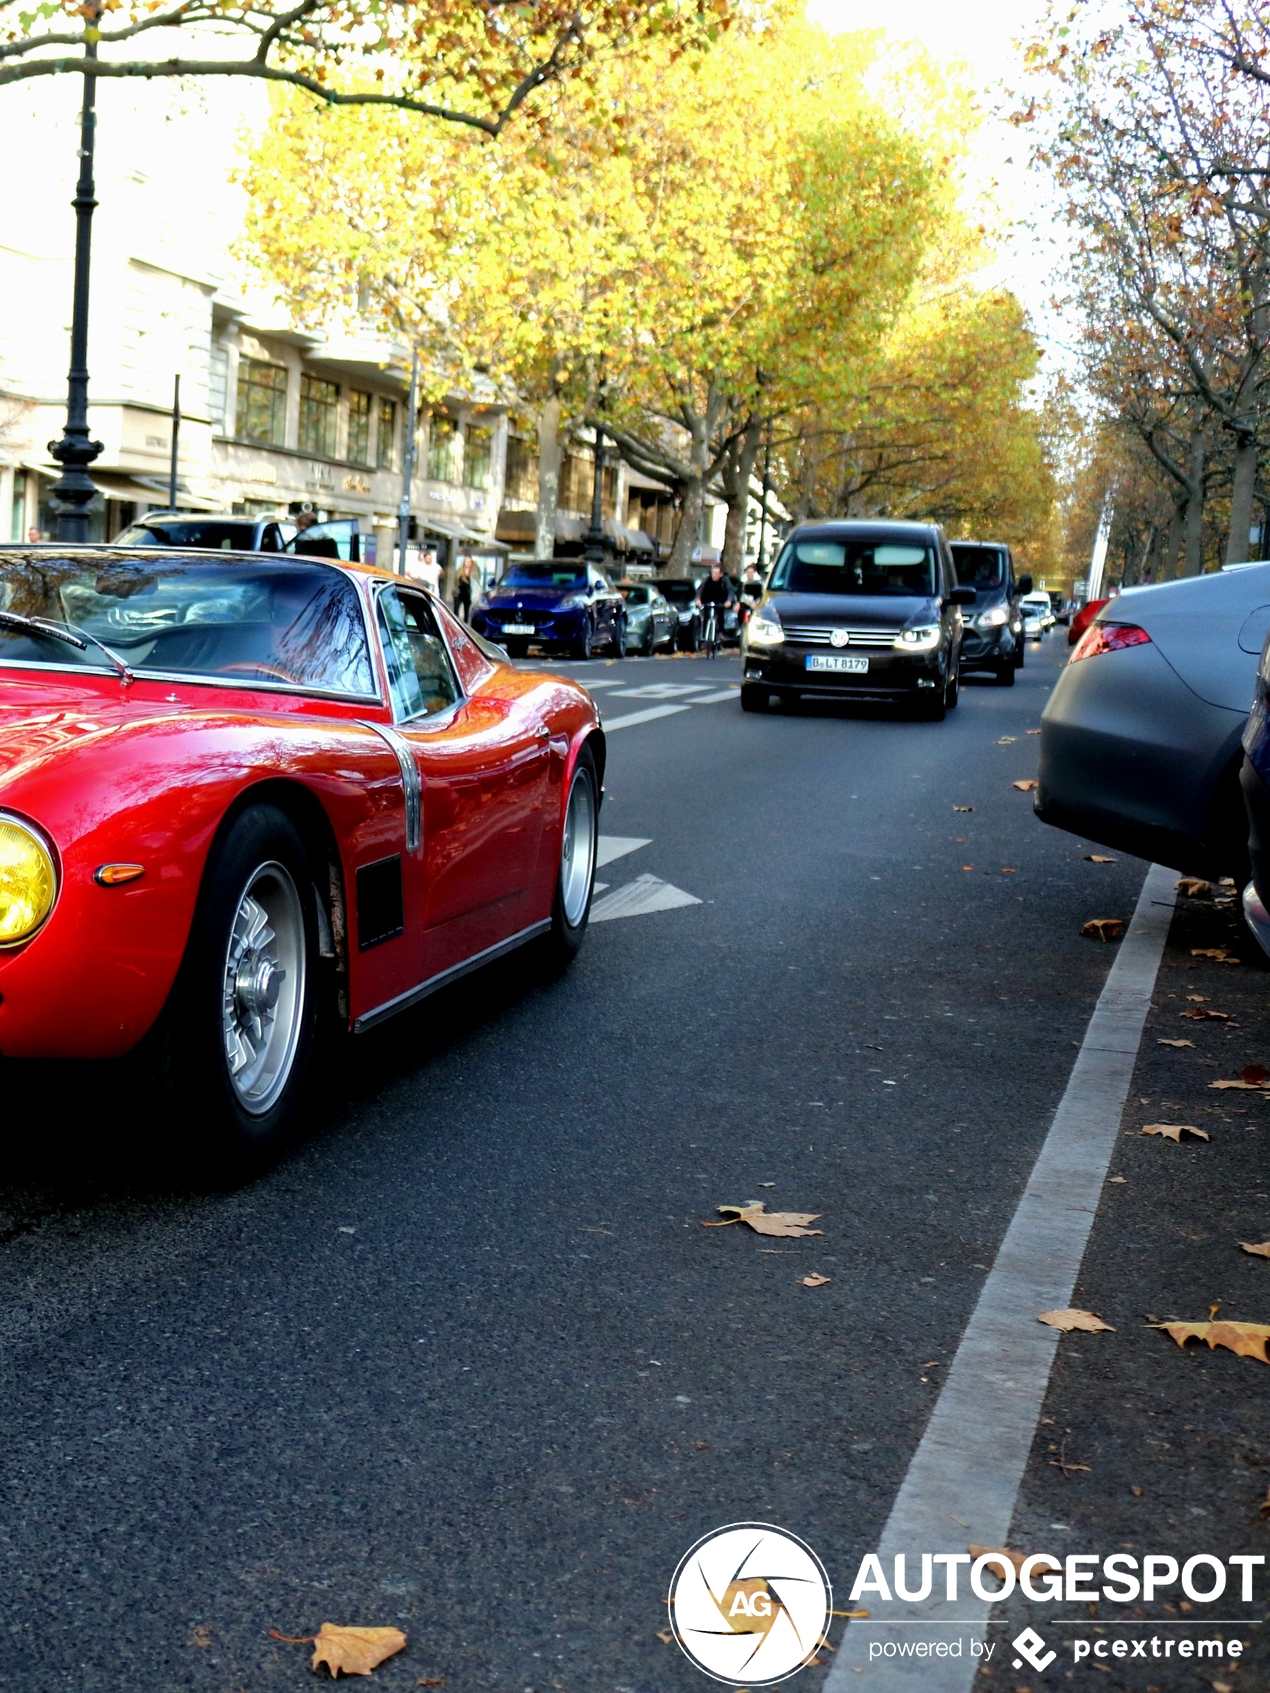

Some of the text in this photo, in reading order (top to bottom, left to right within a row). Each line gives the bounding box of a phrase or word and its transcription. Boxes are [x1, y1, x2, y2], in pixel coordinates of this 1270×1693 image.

[812, 657, 868, 670] B LT 8179
